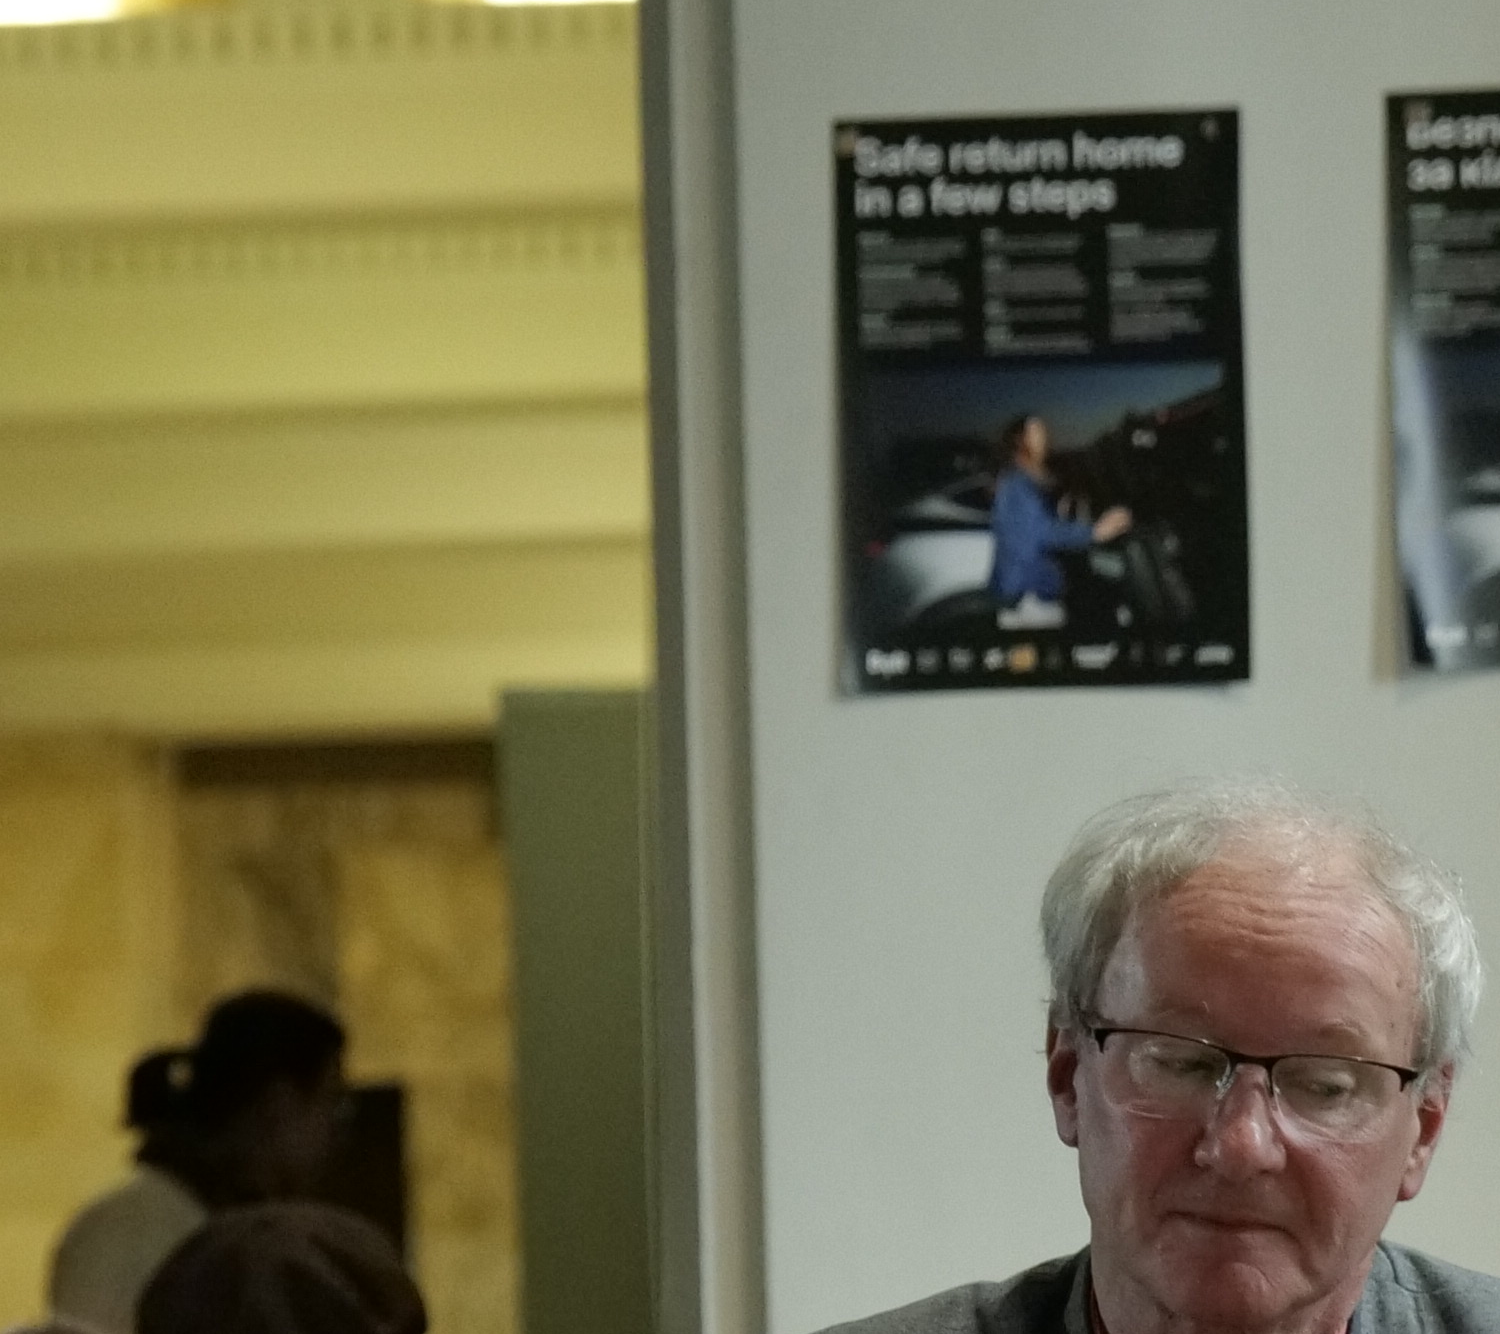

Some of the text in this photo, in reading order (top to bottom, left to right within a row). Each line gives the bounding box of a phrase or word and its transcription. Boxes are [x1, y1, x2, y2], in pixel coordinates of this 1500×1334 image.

[854, 129, 1186, 178] Safe return home
[854, 175, 1119, 220] in a few steps
